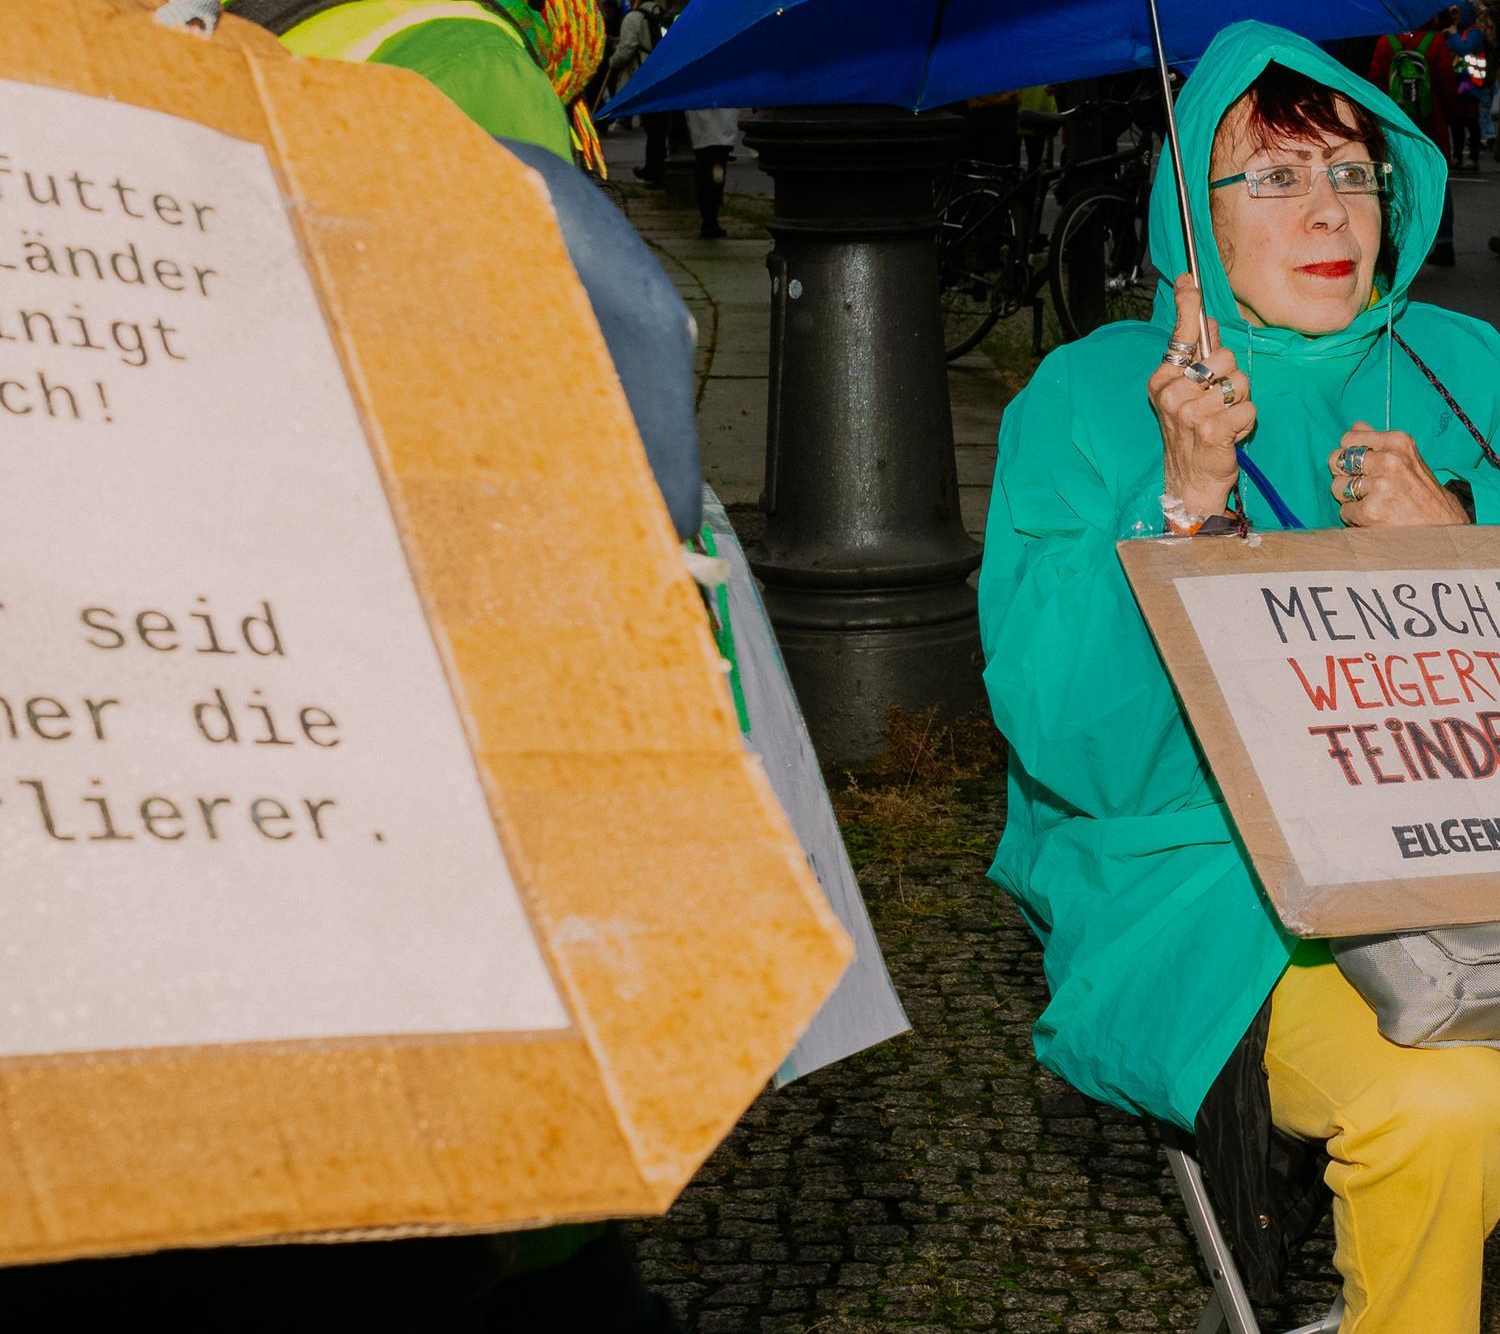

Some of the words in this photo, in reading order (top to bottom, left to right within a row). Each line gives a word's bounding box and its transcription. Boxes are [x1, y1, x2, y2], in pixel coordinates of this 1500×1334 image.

[0, 152, 216, 232] utter
[0, 371, 113, 423] ch!
[80, 597, 287, 657] seid
[192, 687, 341, 748] die
[0, 778, 385, 843] lierer.
